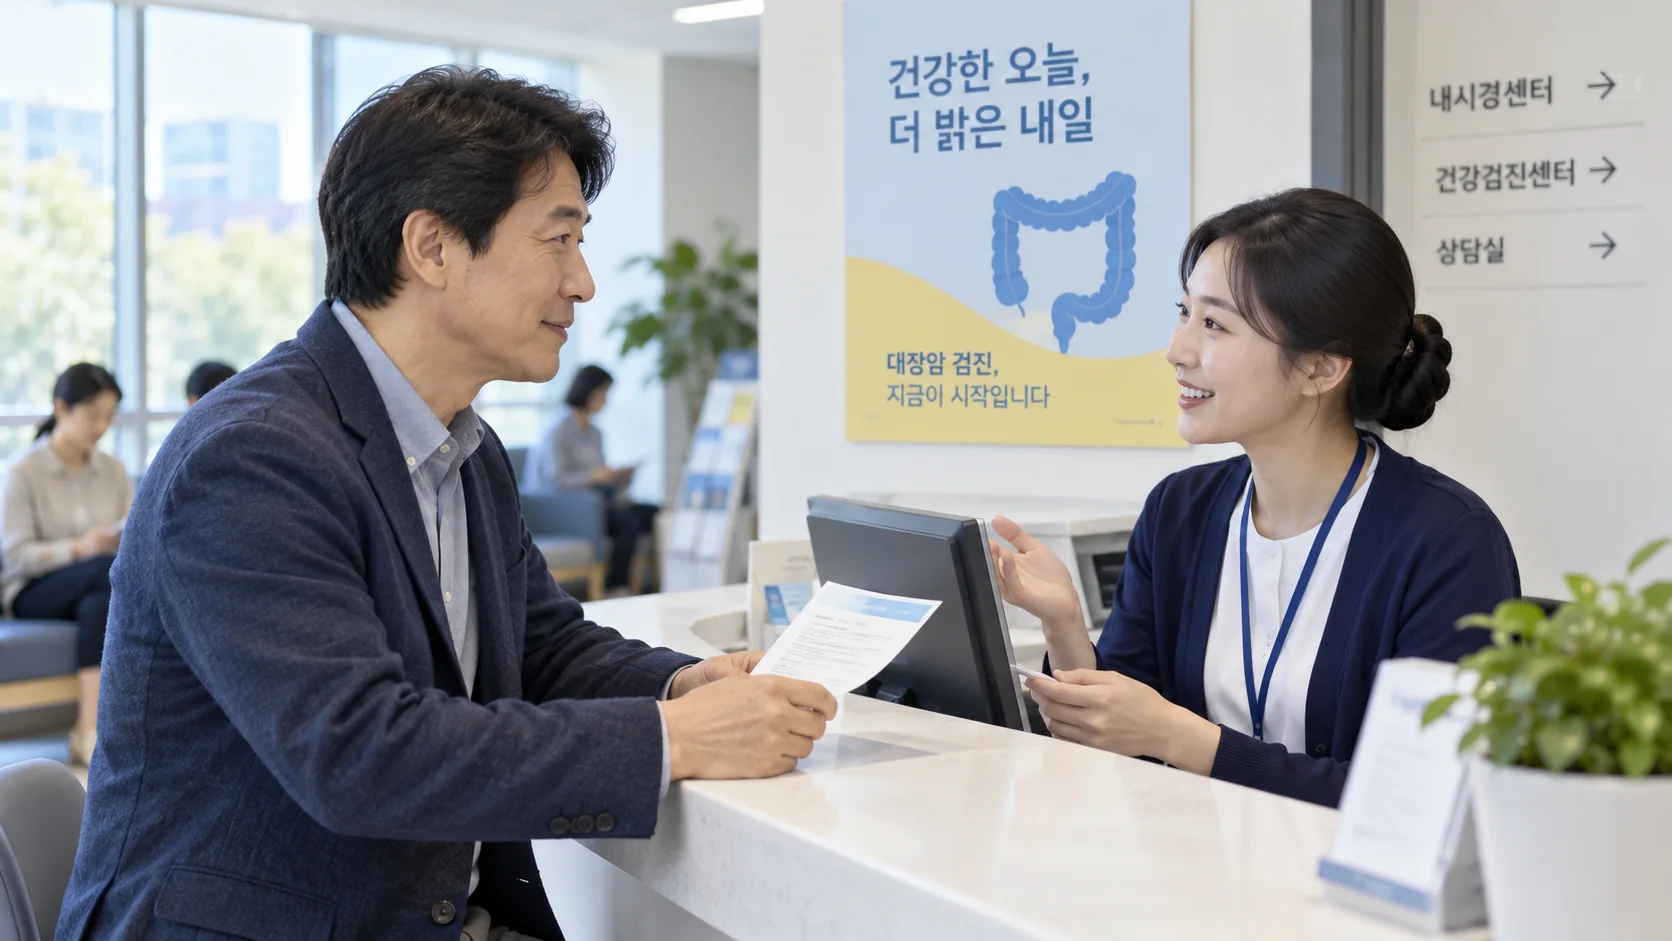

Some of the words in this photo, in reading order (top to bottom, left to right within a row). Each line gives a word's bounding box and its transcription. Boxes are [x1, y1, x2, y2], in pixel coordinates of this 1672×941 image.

[889, 49, 993, 99] 건강한
[1005, 43, 1089, 86] 오늘,
[1430, 76, 1552, 112] 내시경센터
[890, 111, 919, 153] 더
[936, 105, 1006, 151] 밝은
[1021, 96, 1094, 144] 내일
[1436, 159, 1574, 193] 건강검진센터
[1437, 237, 1503, 265] 상담실
[888, 352, 946, 375] 대장암
[953, 352, 998, 377] 검진,
[887, 384, 944, 407] 지금이
[951, 384, 1050, 408] 시작입니다
